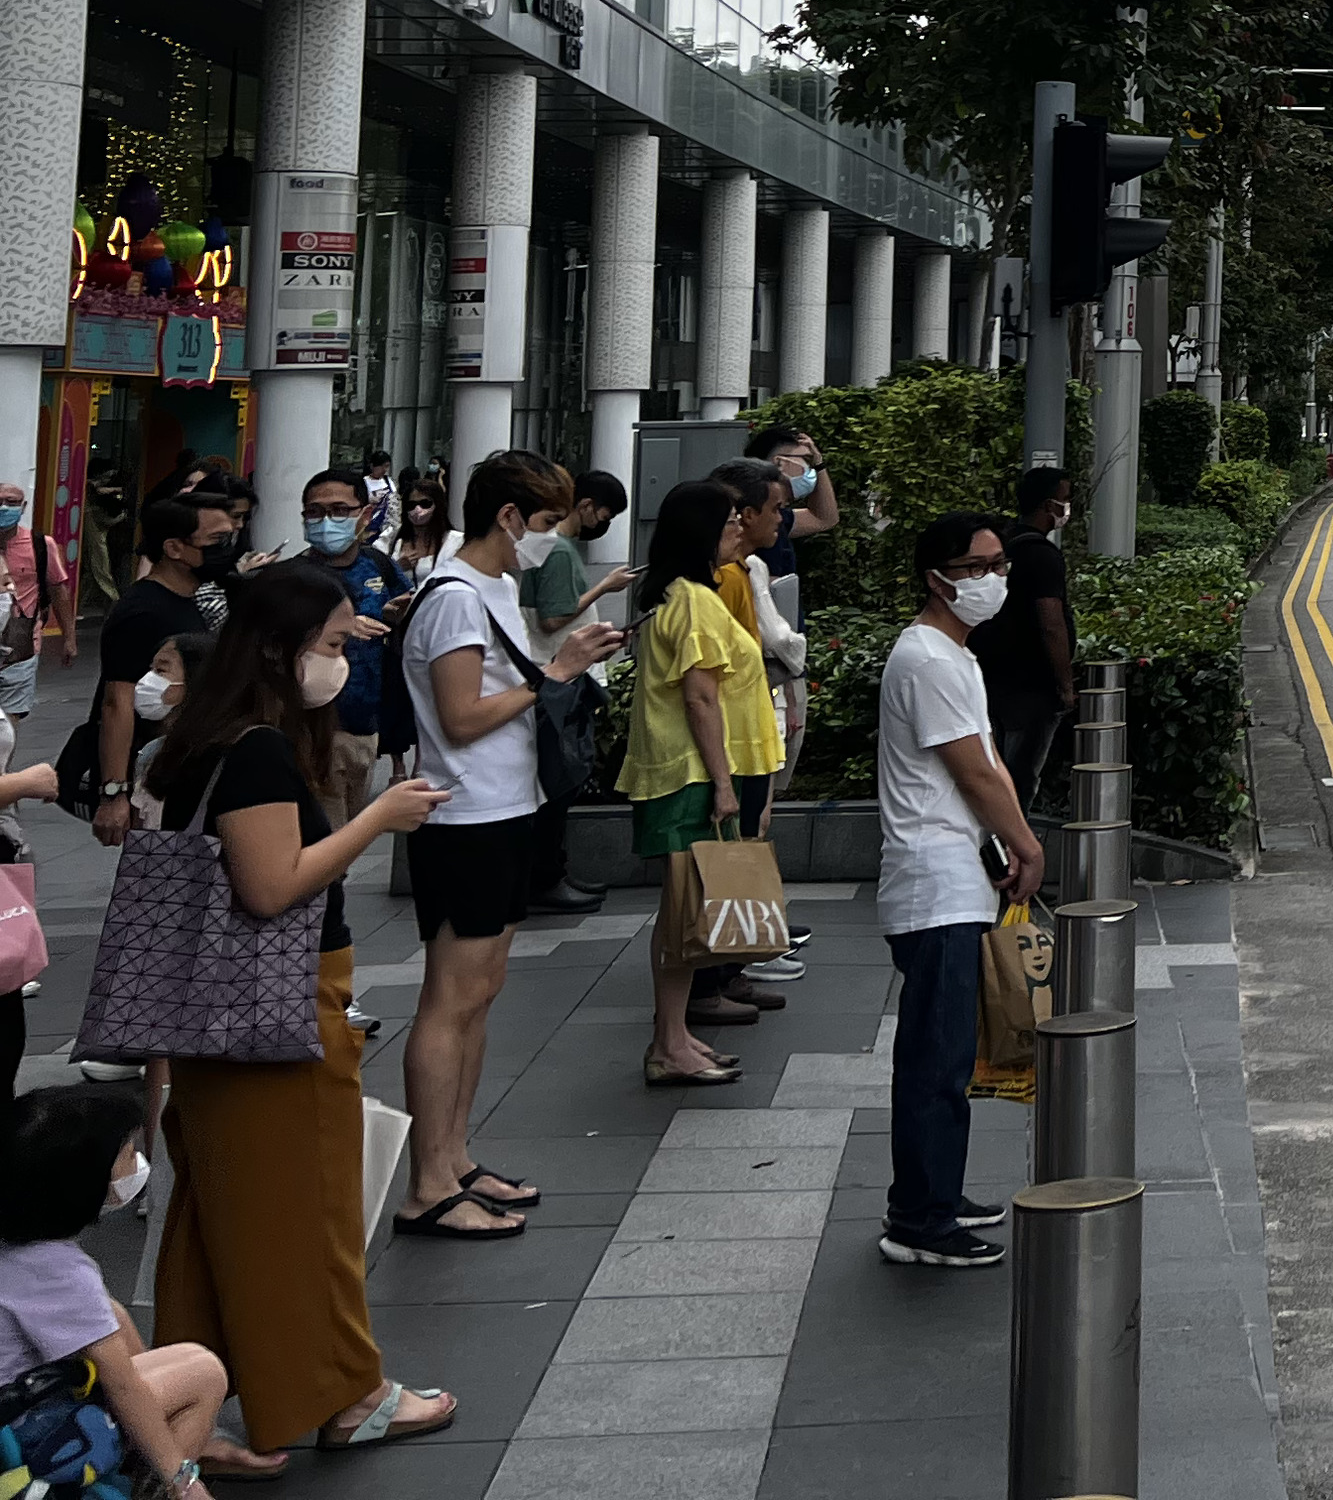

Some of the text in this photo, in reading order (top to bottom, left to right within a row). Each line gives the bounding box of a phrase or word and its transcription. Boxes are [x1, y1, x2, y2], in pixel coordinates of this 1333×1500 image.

[289, 178, 324, 189] food
[293, 254, 351, 267] SONY
[177, 322, 201, 359] 313
[298, 351, 326, 362] MUJI
